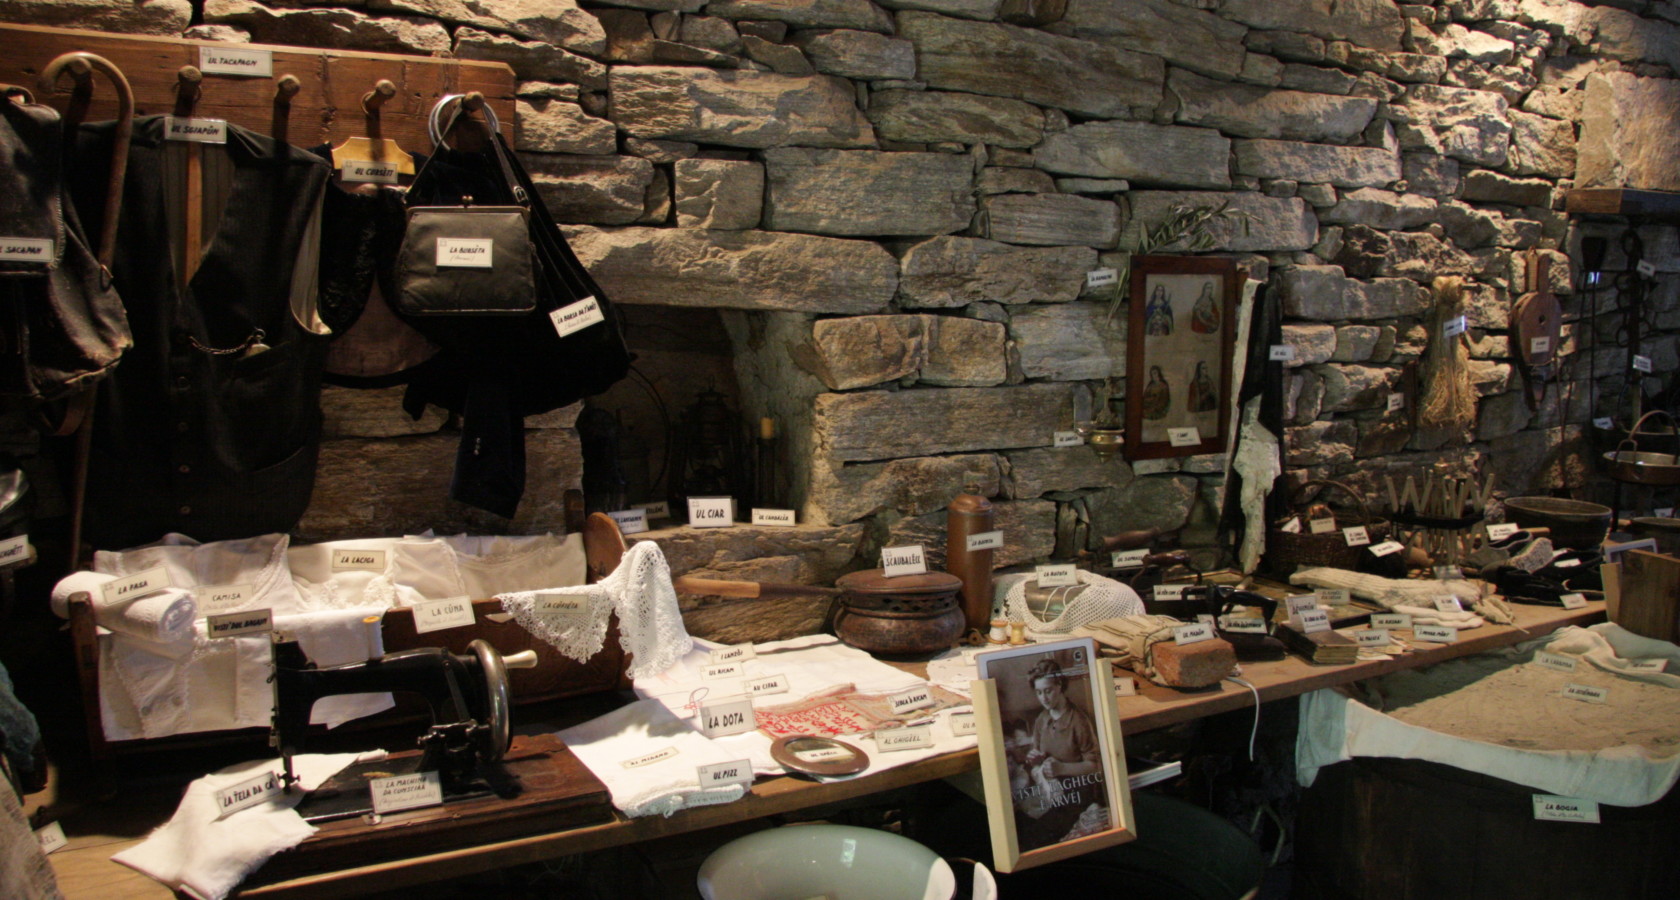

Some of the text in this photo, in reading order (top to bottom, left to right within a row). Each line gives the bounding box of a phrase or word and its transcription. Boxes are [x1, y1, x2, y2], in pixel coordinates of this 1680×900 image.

[696, 508, 725, 519] UL CIAR
[118, 586, 128, 595] LA
[212, 593, 242, 603] CAMISA
[431, 608, 442, 617] LA
[709, 712, 745, 729] LA DOTA
[713, 768, 738, 780] UL PIZZ
[386, 781, 395, 789] LA
[224, 796, 234, 808] LA
[253, 784, 264, 797] DA
